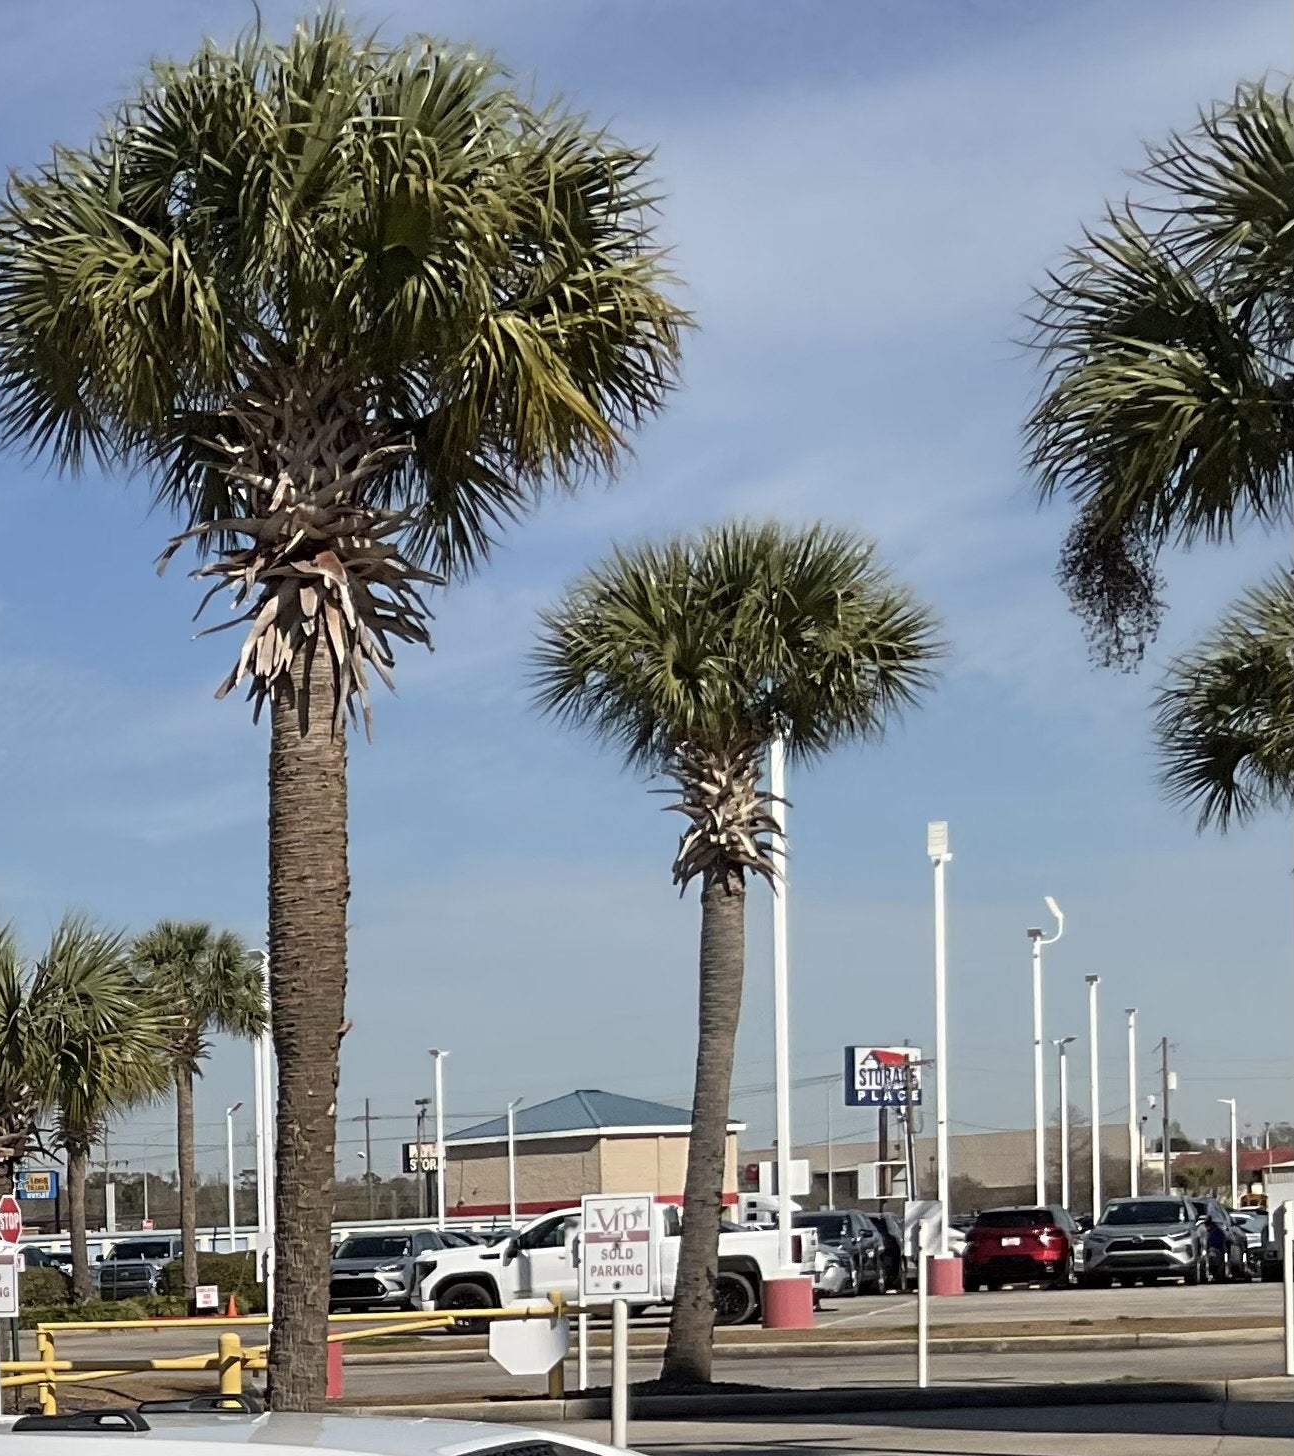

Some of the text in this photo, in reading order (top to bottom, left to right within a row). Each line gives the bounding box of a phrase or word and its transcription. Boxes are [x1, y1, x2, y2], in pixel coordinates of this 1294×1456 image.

[857, 1090, 919, 1101] PLACE
[0, 1212, 20, 1230] STOP
[601, 1248, 633, 1261] SOLD
[590, 1264, 644, 1277] PARKING
